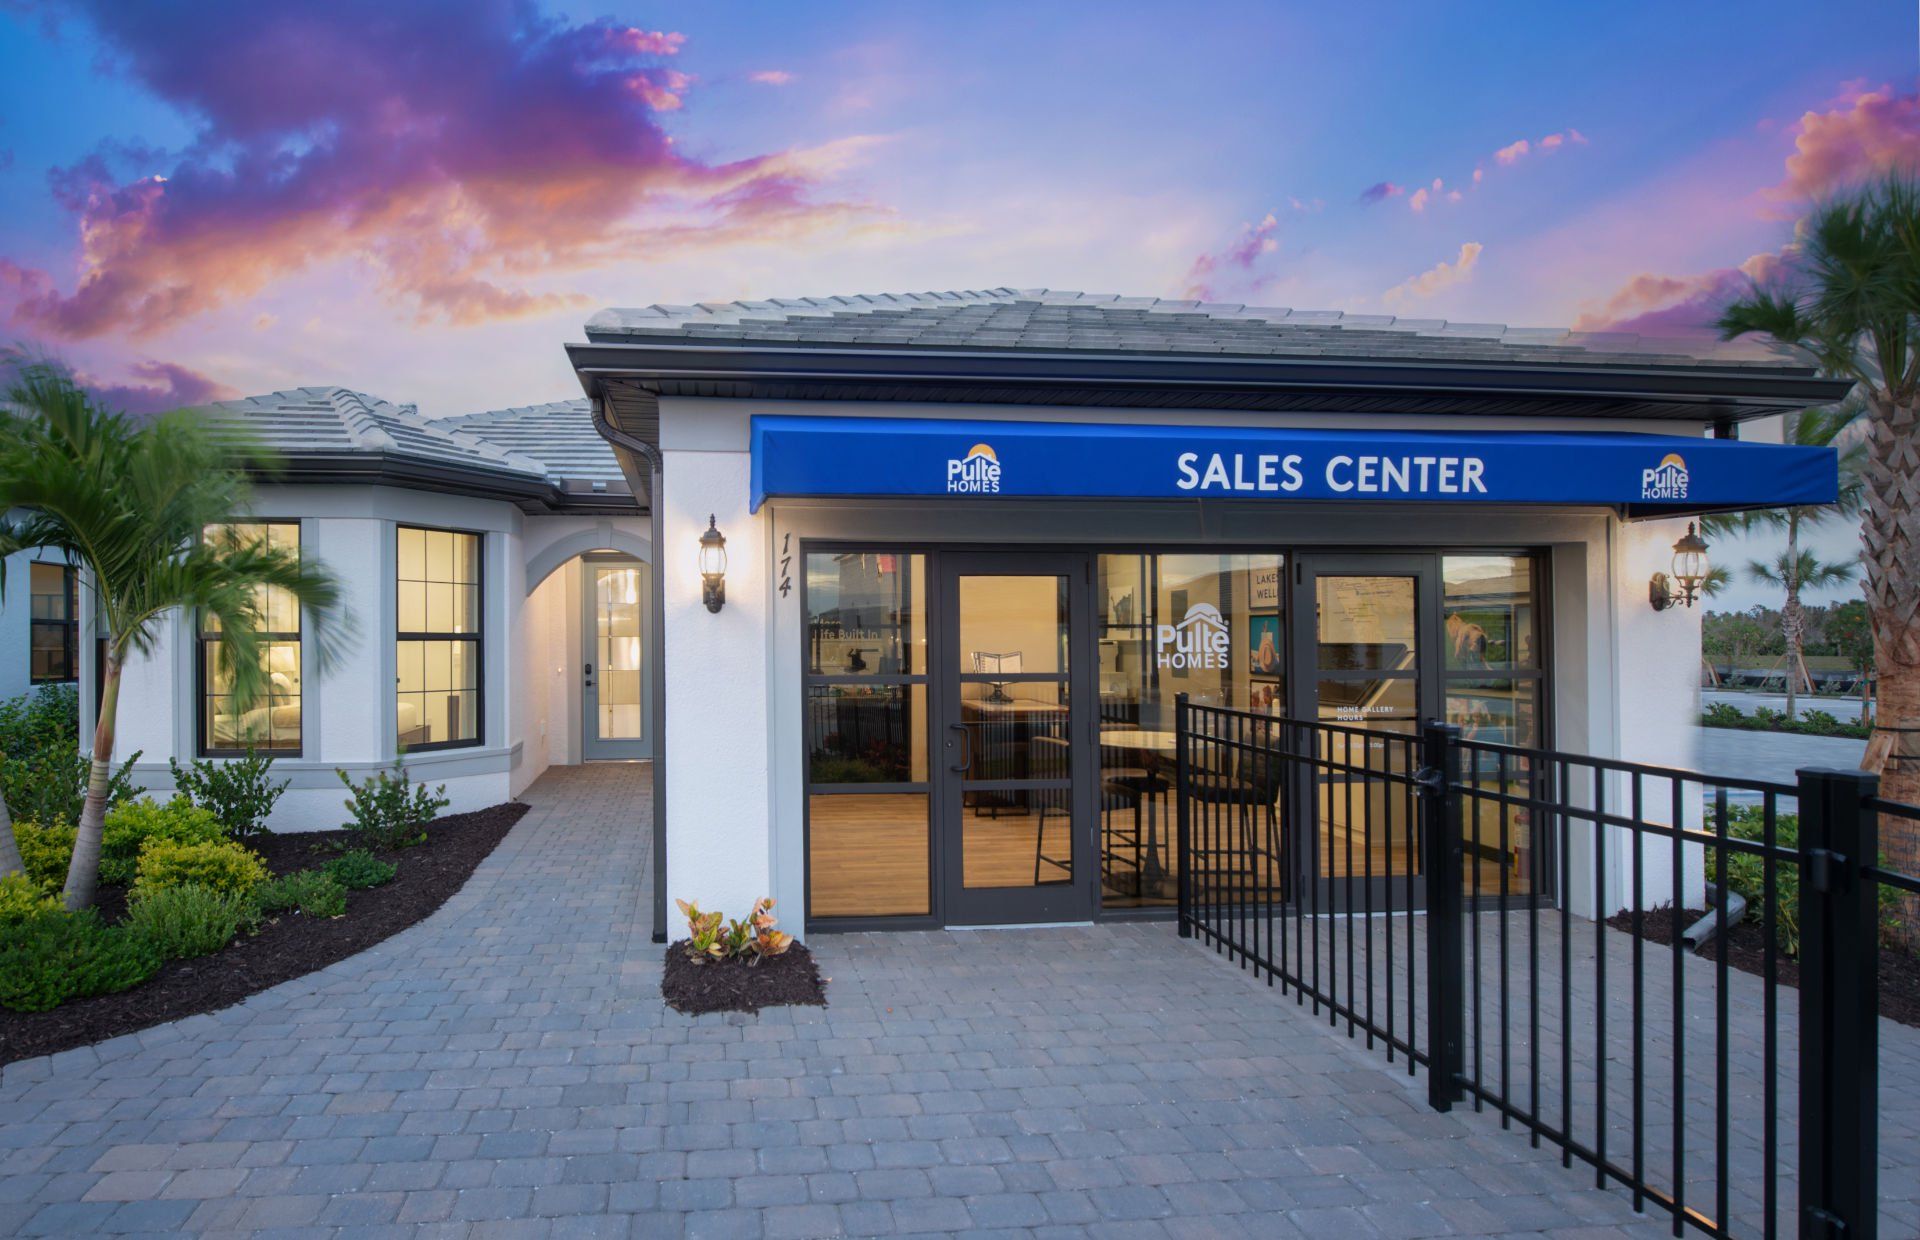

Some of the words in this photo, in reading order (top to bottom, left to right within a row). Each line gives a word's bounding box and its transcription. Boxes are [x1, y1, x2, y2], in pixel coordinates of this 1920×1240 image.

[947, 456, 1001, 481] Pulte
[1176, 452, 1303, 491] SALES
[1325, 455, 1488, 493] CENTER
[1642, 466, 1689, 488] Pulte
[947, 481, 1000, 493] HOMES
[1642, 488, 1688, 499] HOMES
[779, 533, 791, 598] 174
[838, 628, 865, 640] Built
[1157, 621, 1230, 653] Pulte
[1157, 653, 1229, 669] HOMES
